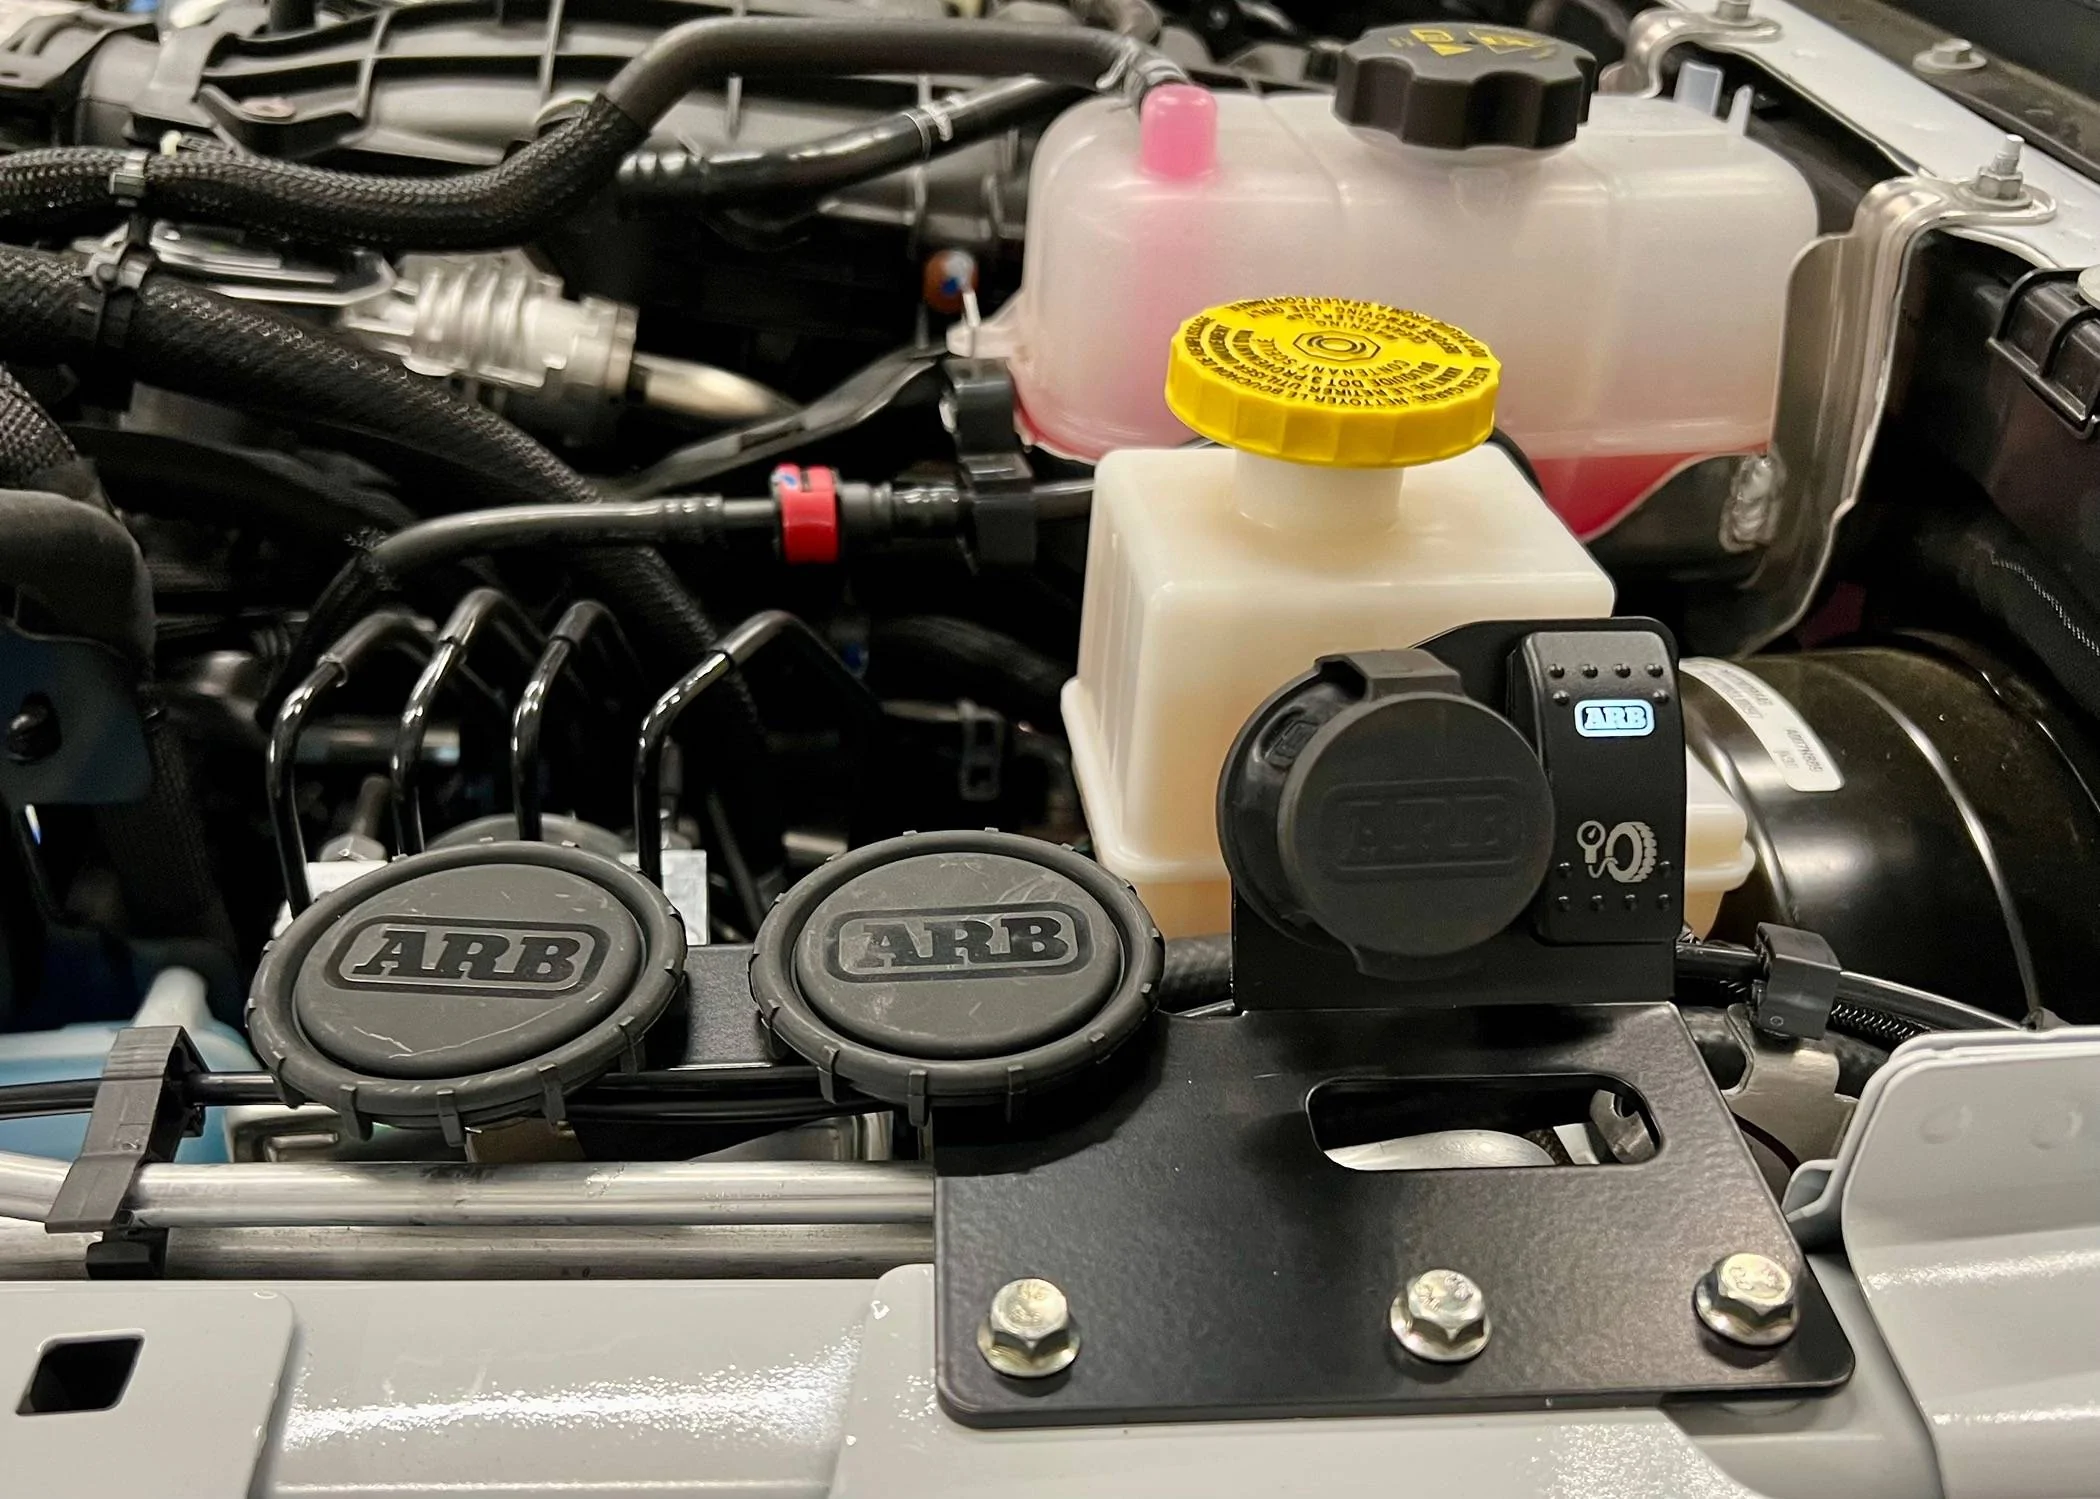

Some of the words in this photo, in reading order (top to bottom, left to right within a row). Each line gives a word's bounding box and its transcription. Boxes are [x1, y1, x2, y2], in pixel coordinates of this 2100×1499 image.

[1292, 304, 1321, 313] USE
[1298, 359, 1410, 377] CONTENANT
[1312, 376, 1322, 384] 3
[1328, 378, 1364, 388] DOT
[1286, 391, 1309, 400] LE
[1314, 395, 1409, 407] NETTOYER
[1583, 705, 1648, 730] ARB
[860, 915, 1071, 967] ARB
[352, 928, 582, 983] ARB
